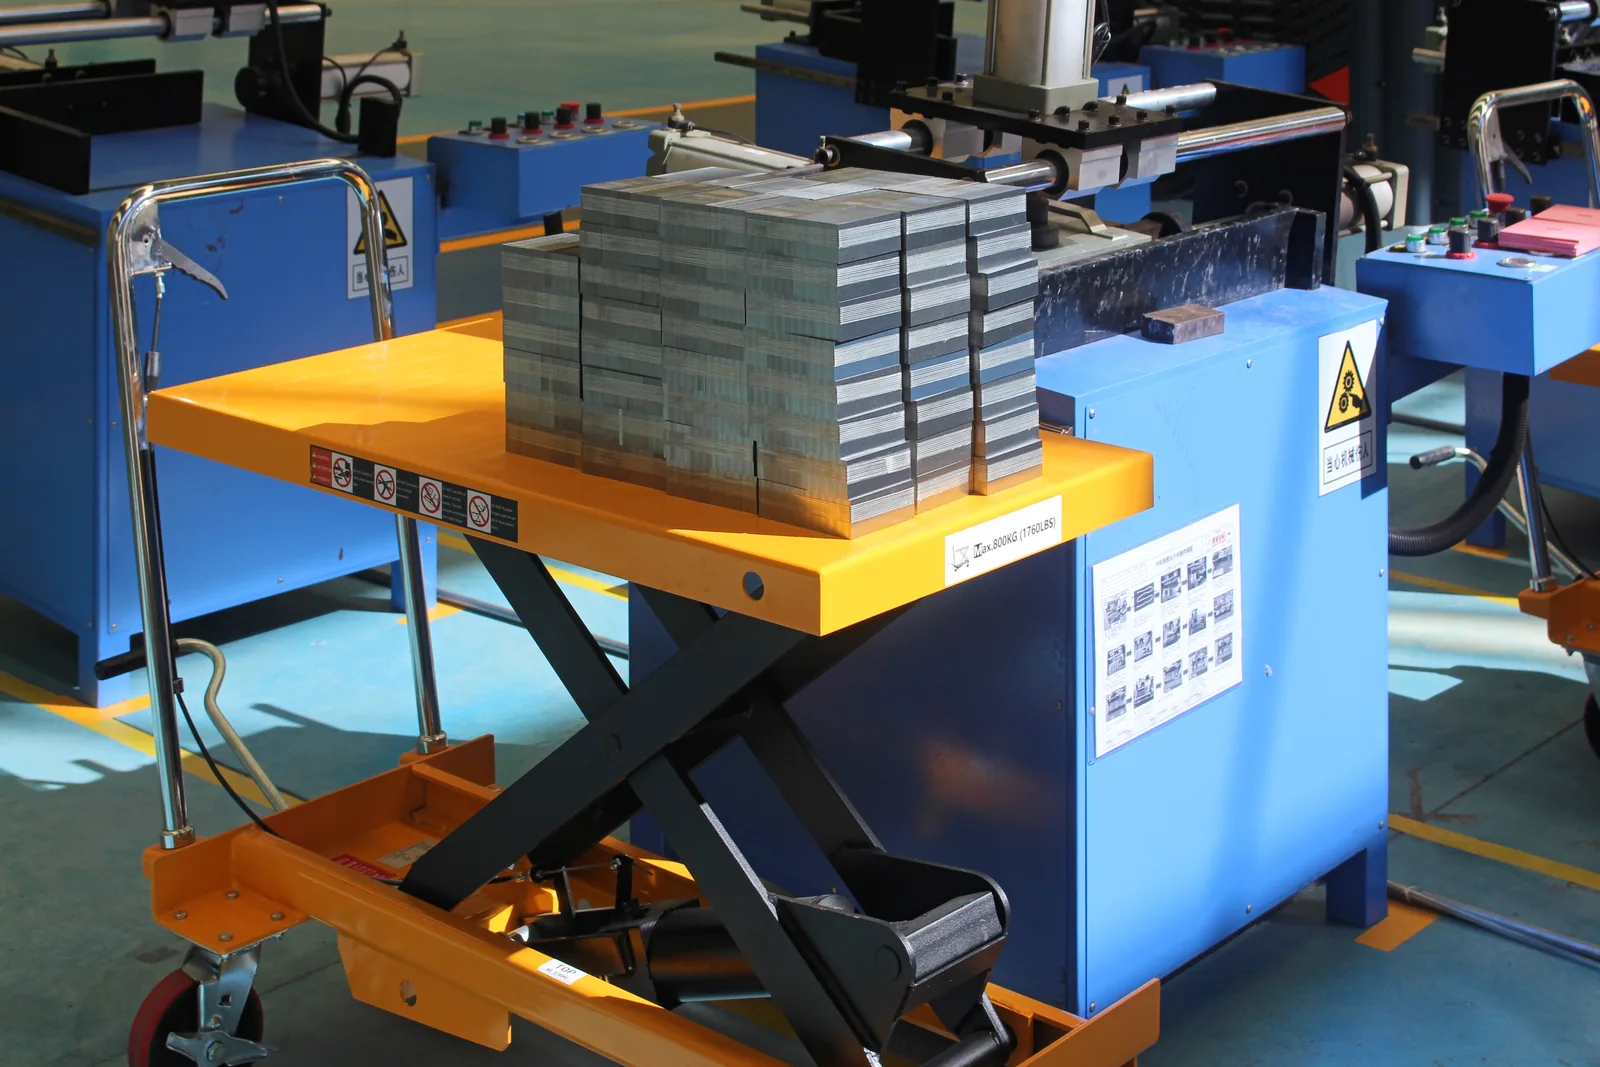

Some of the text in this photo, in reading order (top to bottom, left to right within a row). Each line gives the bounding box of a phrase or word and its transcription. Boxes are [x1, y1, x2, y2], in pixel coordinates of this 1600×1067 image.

[1326, 441, 1369, 474] 当心机械伤人
[973, 516, 1056, 558] Max.800KG (1760LBS)
[556, 964, 577, 974] TOP
